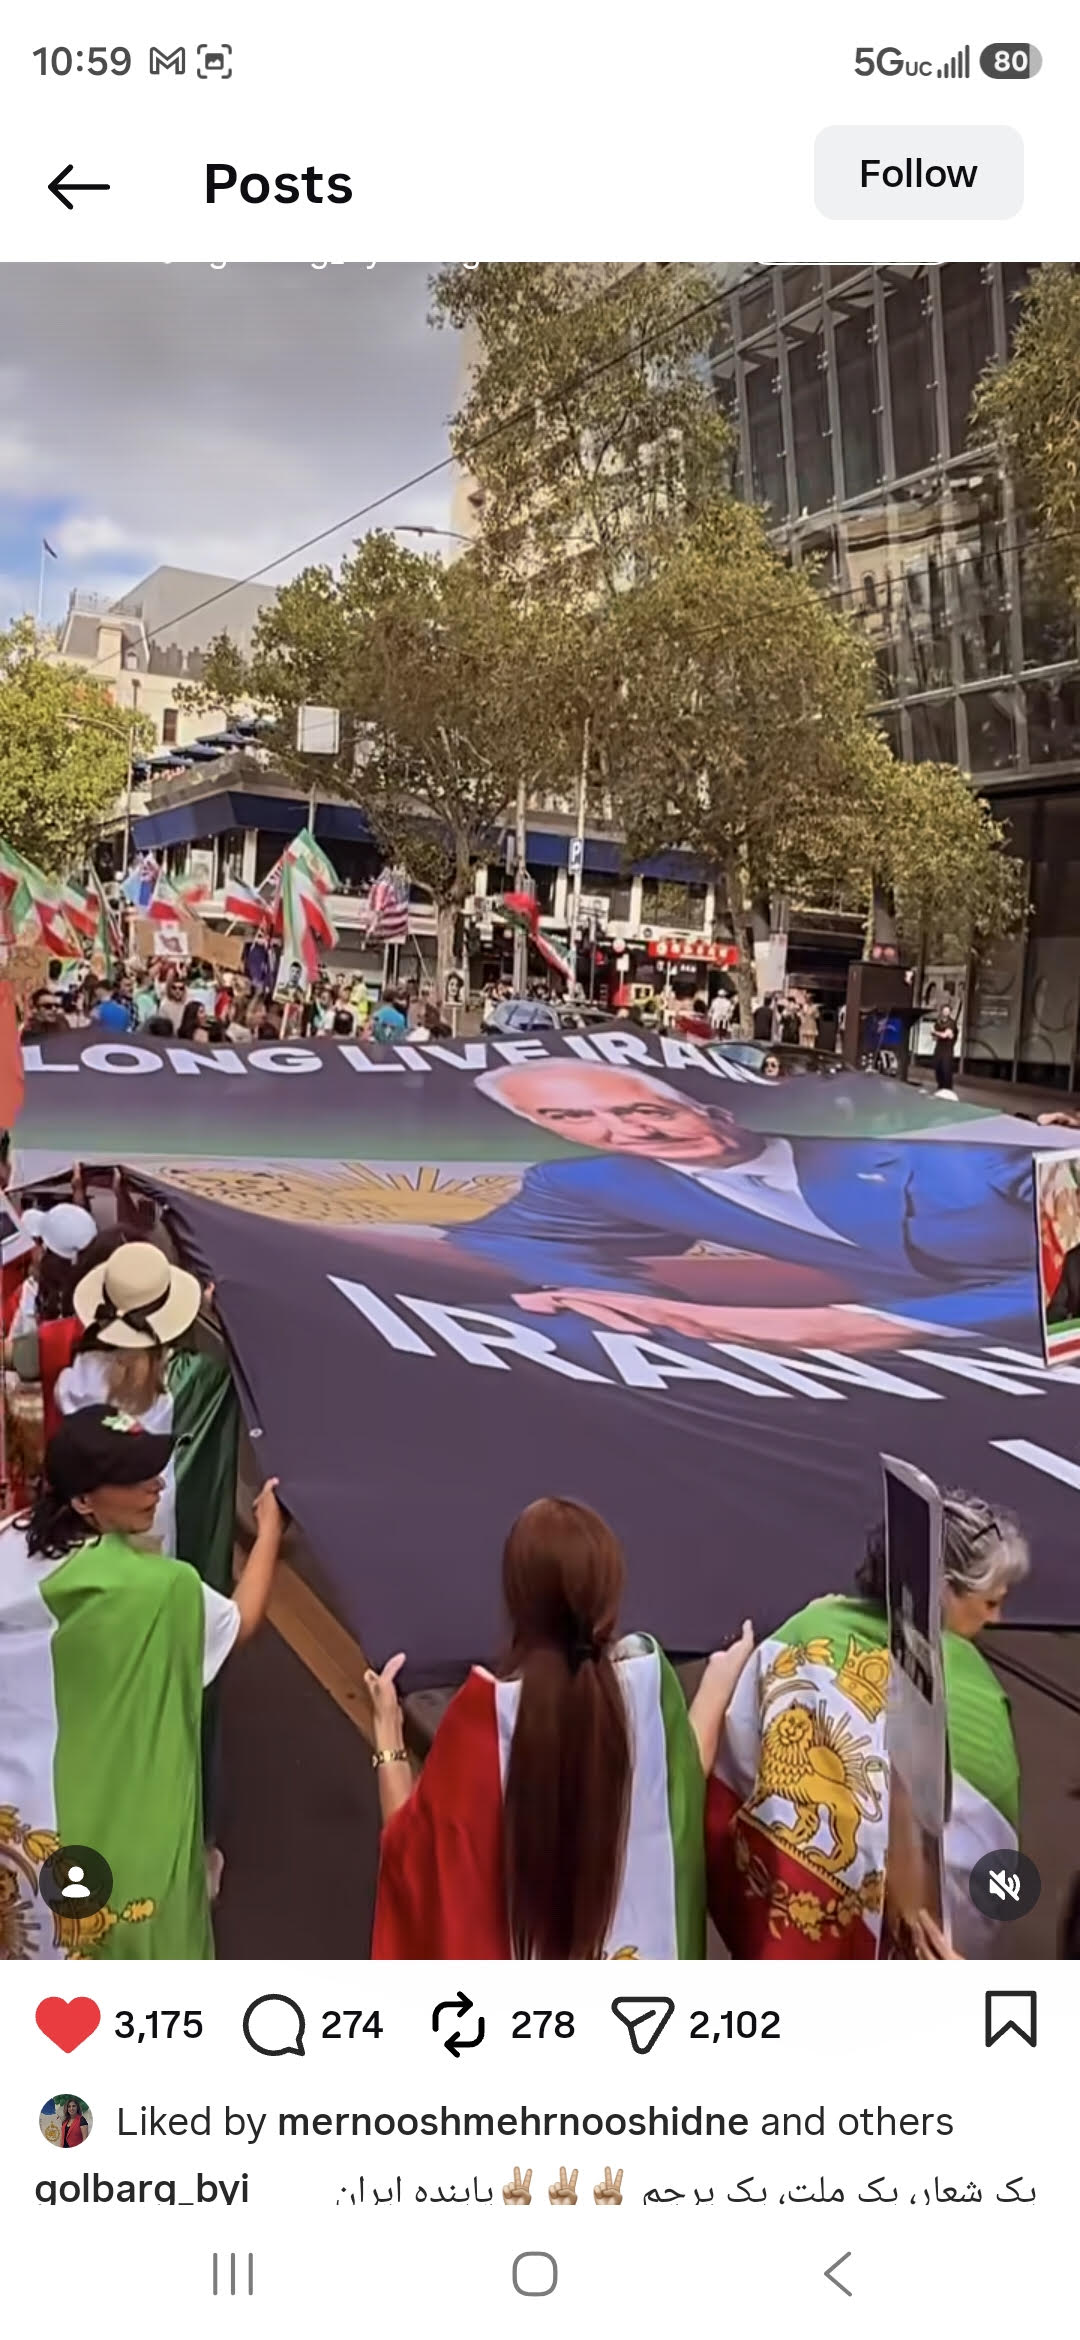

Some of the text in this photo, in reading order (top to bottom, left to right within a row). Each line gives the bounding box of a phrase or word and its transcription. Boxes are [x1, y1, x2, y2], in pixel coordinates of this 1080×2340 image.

[572, 841, 582, 862] P
[21, 1043, 323, 1074] LONG
[337, 1039, 549, 1072] LIVE
[327, 1274, 947, 1400] IRAN
